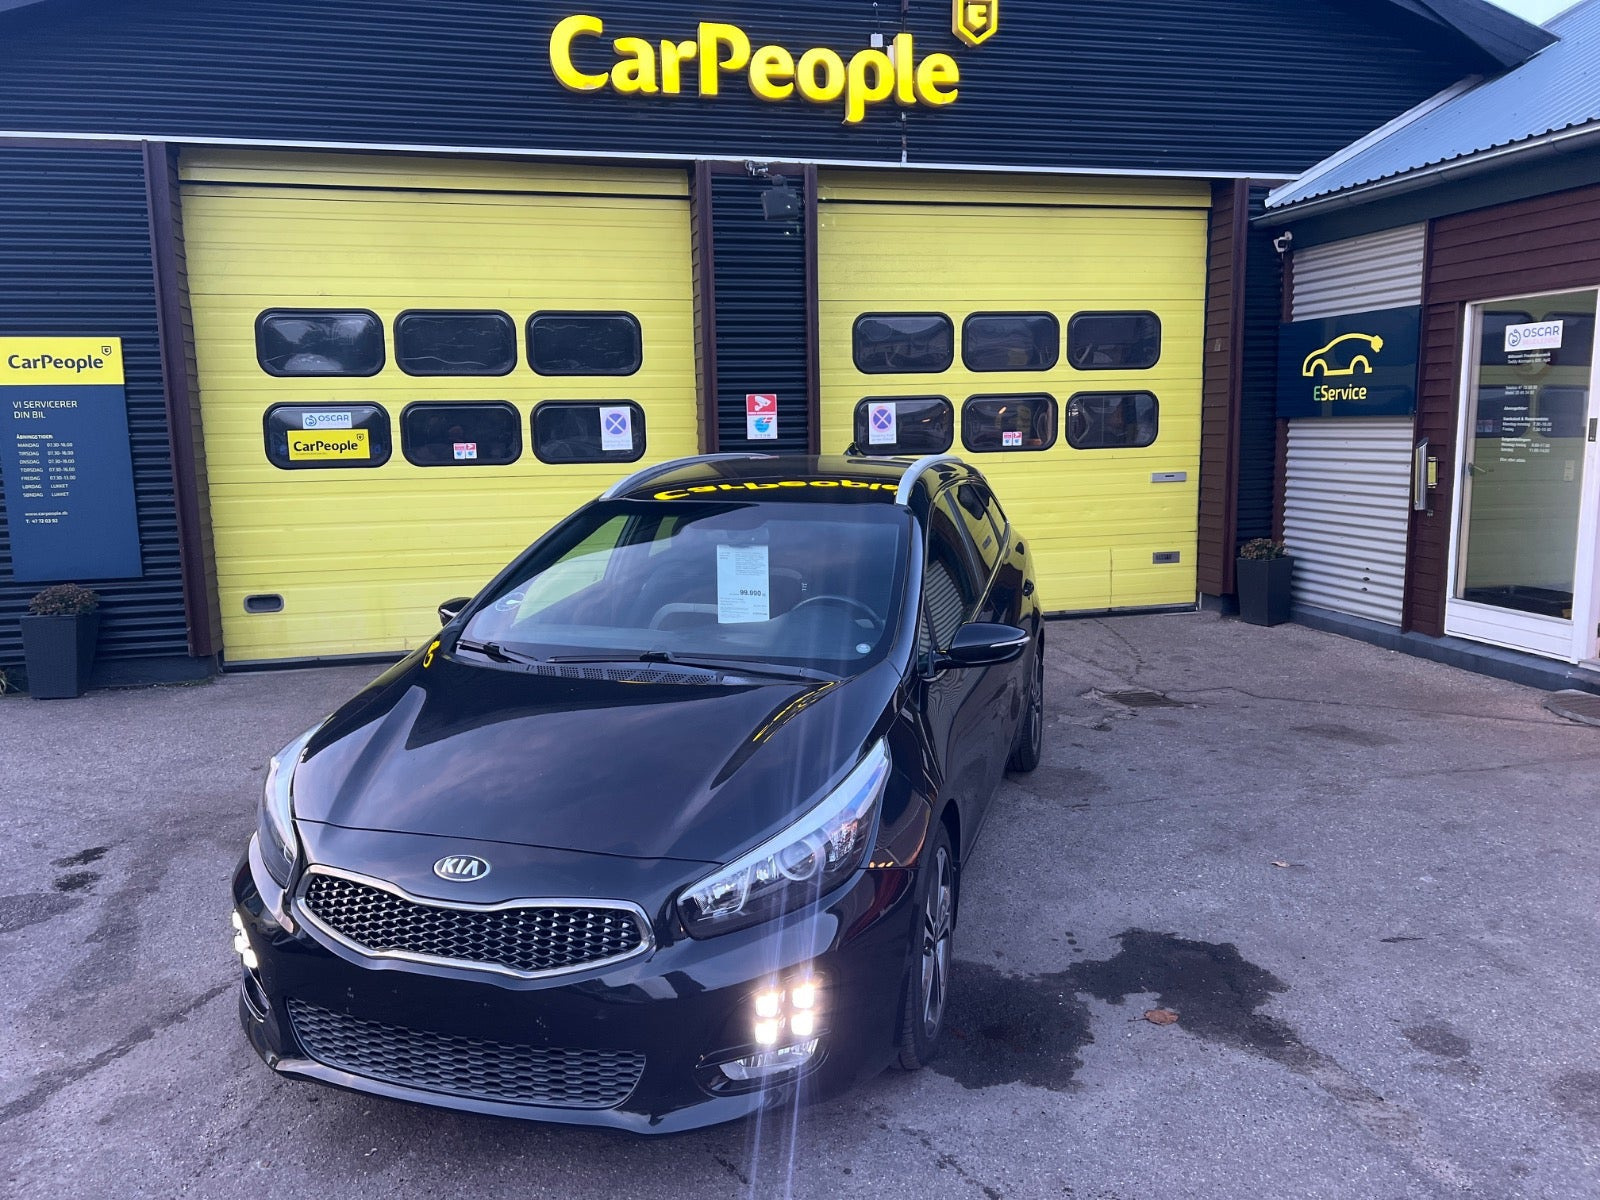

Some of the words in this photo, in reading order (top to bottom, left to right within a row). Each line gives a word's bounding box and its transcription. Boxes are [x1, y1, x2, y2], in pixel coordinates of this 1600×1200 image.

[549, 14, 960, 124] CarPeople
[1522, 325, 1561, 338] OSCAR
[8, 354, 104, 373] CarPeople
[1313, 384, 1368, 401] EService
[12, 401, 22, 409] VI
[23, 400, 78, 409] SERVICERER
[14, 411, 31, 419] DIN
[32, 411, 46, 419] BIL
[317, 414, 350, 422] OSCAR
[293, 440, 359, 454] CarPeople
[440, 858, 479, 877] KIA
